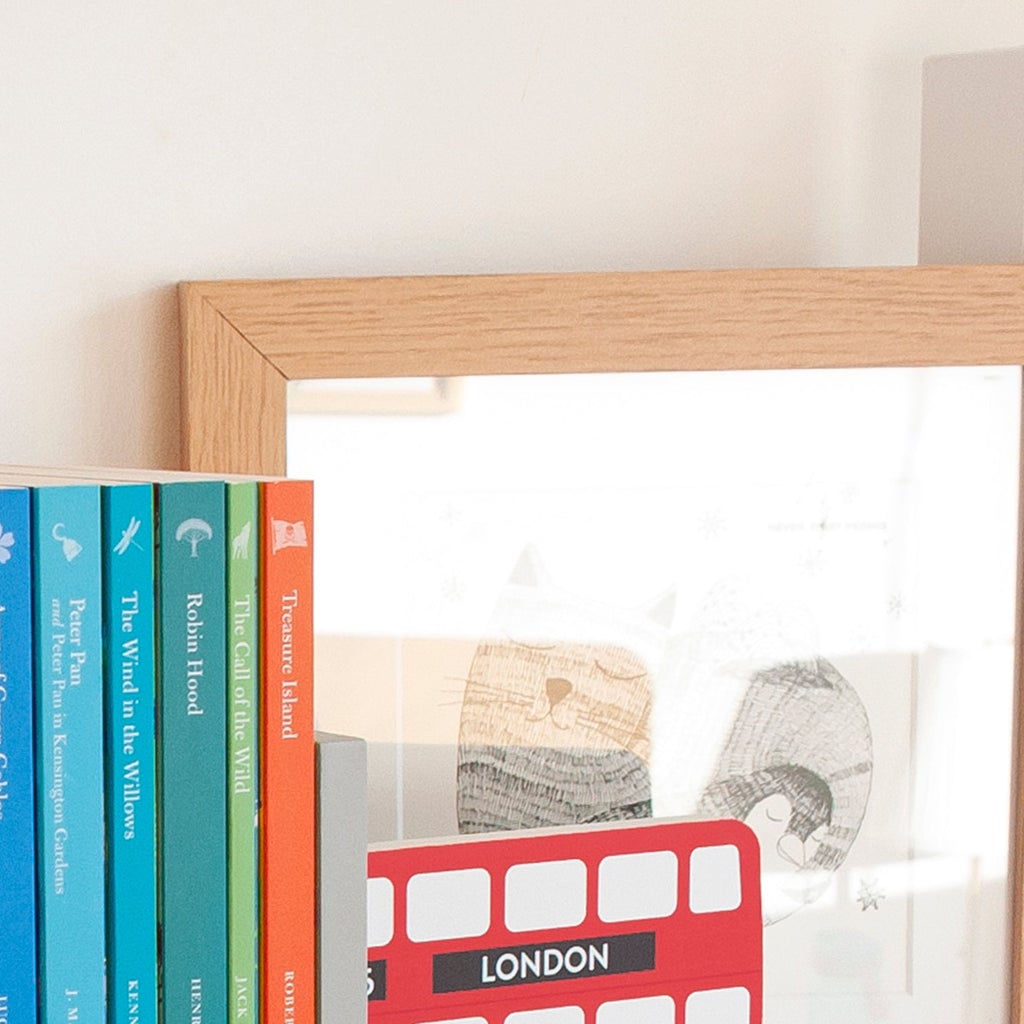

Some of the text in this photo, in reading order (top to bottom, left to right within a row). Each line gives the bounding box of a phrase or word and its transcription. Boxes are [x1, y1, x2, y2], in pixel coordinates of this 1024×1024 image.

[69, 599, 85, 685] Peter Pan
[187, 594, 202, 715] Robin Hood
[234, 595, 250, 793] The Call of the Wild
[281, 590, 297, 739] Treasure Island
[50, 599, 68, 894] and Peter Pan in Kensington Gardens
[122, 591, 139, 840] The Wind in the Willows
[65, 989, 79, 1001] J.
[235, 976, 248, 1018] JACK
[481, 943, 609, 984] LONDON
